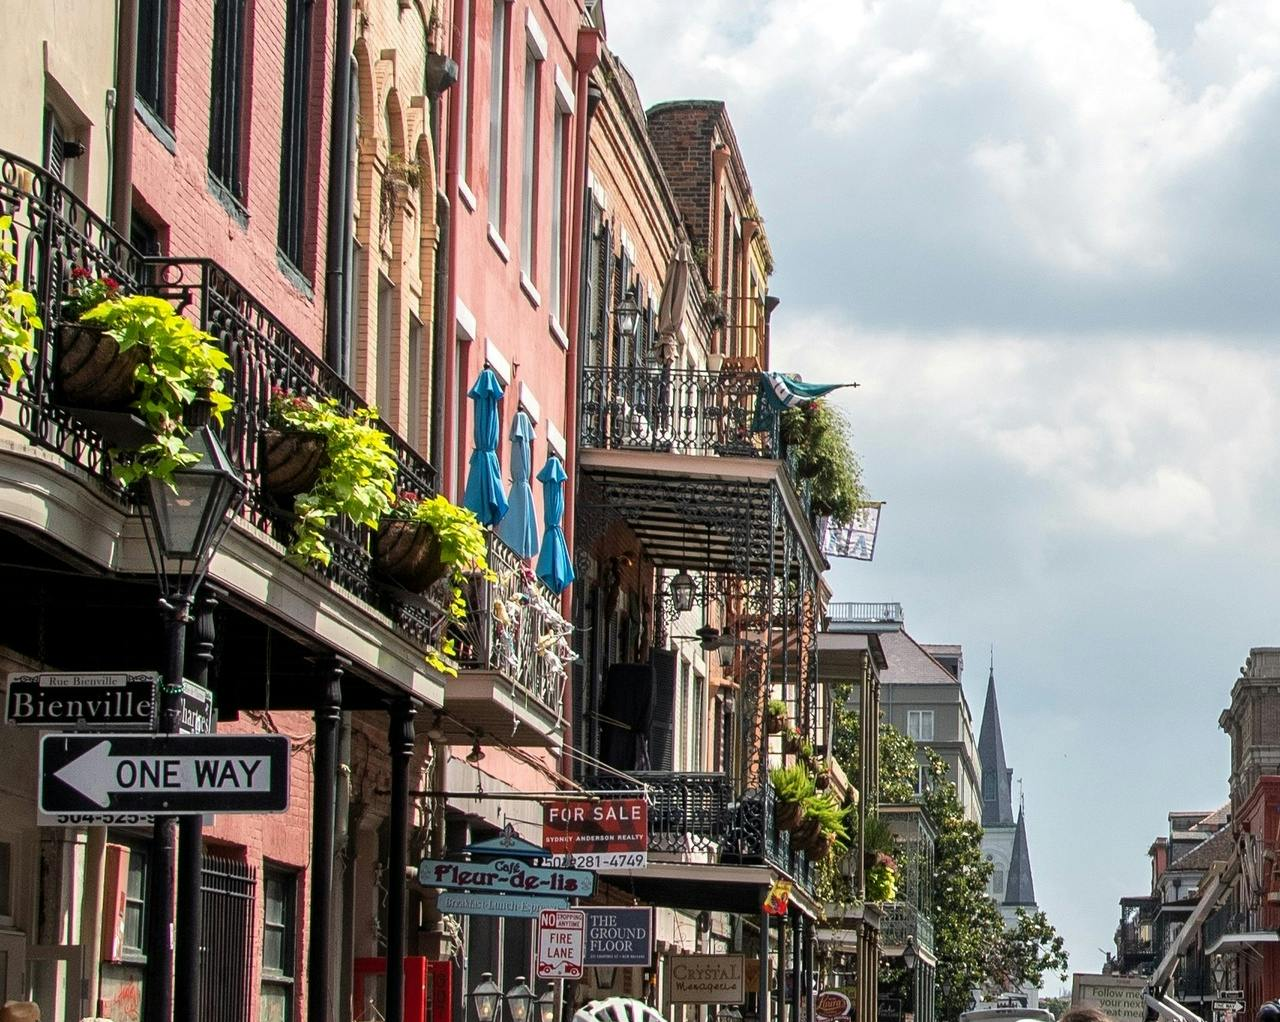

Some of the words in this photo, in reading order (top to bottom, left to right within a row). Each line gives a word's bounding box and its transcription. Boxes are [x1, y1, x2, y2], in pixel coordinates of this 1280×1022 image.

[49, 677, 69, 686] Rue
[73, 677, 118, 686] Bienville
[13, 692, 151, 718] Bienville
[116, 760, 181, 788] ONE
[195, 760, 262, 788] WAY
[549, 807, 584, 822] FOR
[593, 806, 641, 820] SALE
[495, 861, 521, 874] Café
[434, 865, 579, 891] Fleur-de-lis
[541, 913, 556, 927] NO
[590, 915, 617, 926] THE
[550, 933, 572, 944] FIRE
[590, 928, 646, 939] GROUND
[590, 940, 633, 951] FLOOR
[547, 948, 574, 958] LANE
[1092, 988, 1123, 997] Follow
[1100, 1000, 1123, 1009] your
